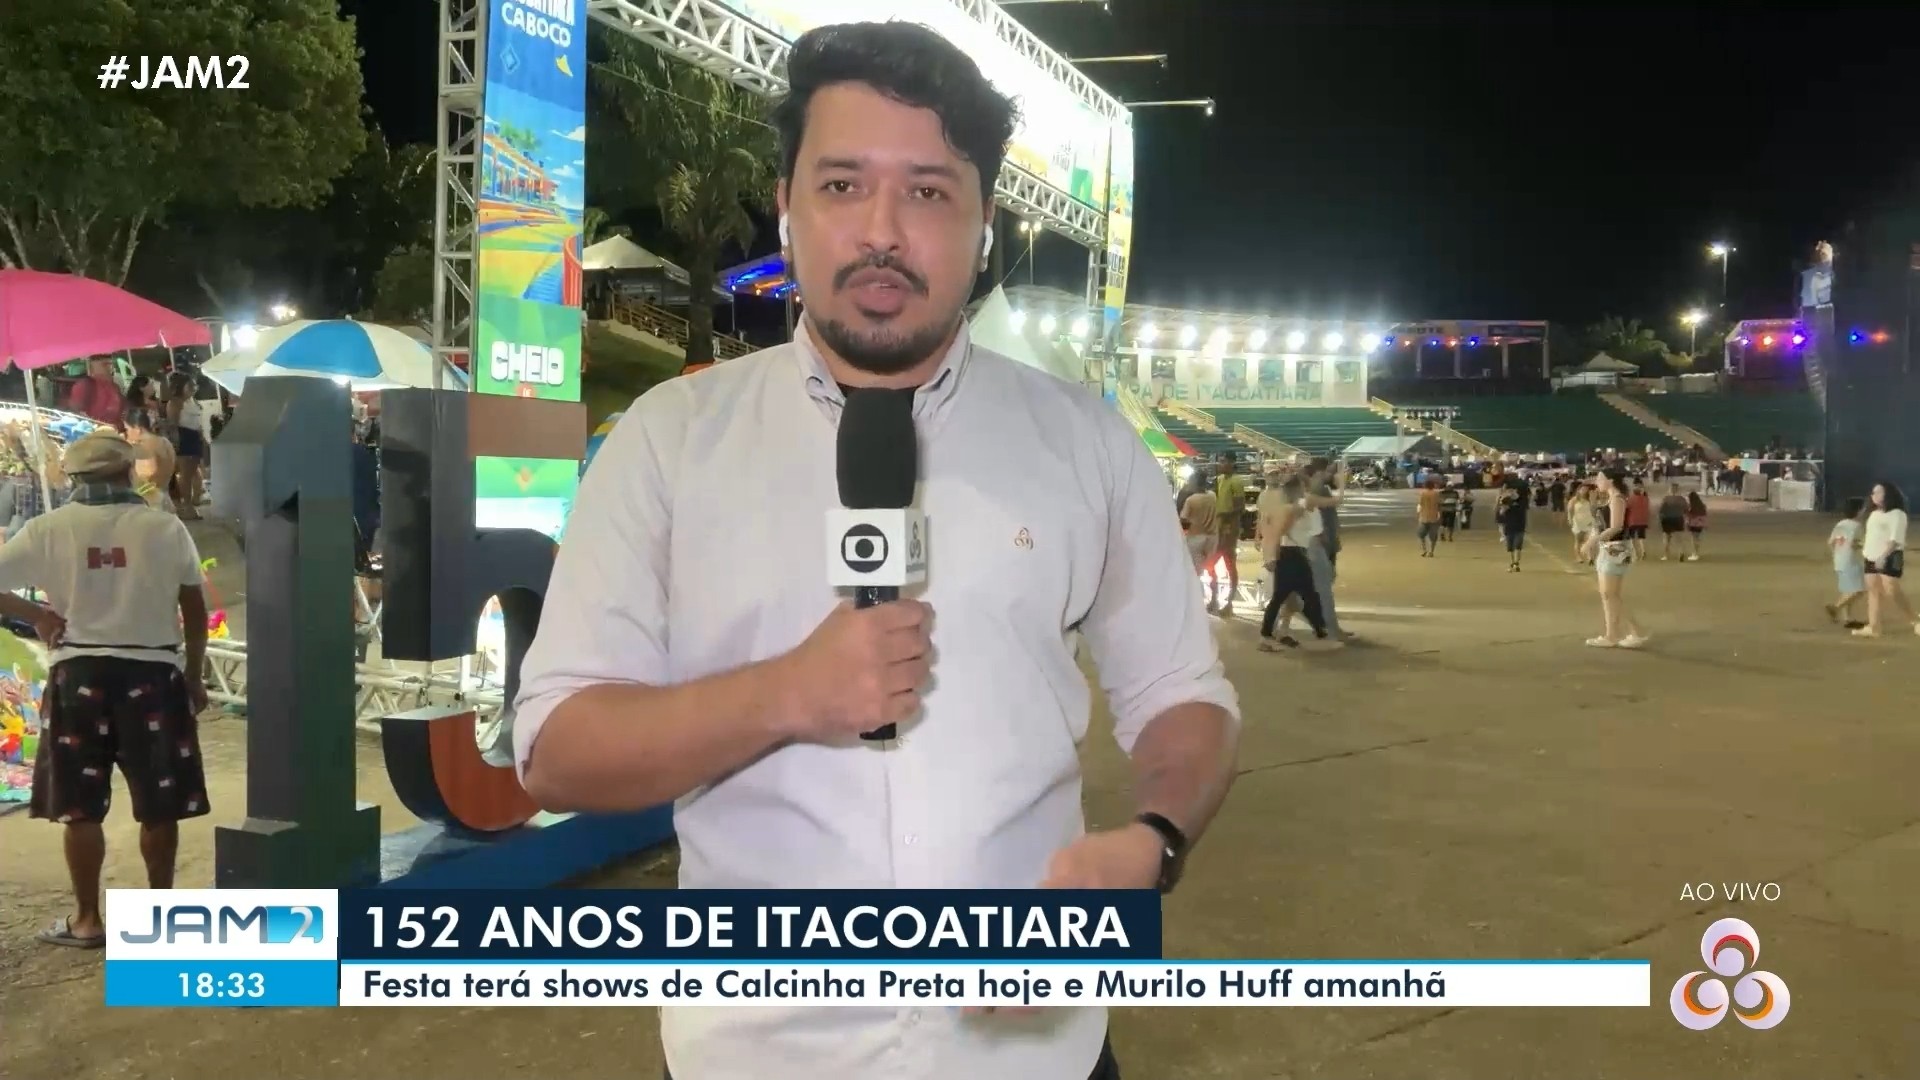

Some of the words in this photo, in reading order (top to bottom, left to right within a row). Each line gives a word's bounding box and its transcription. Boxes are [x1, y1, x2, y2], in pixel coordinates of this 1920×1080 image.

[501, 2, 571, 48] CABOCO
[490, 341, 565, 387] CHEIO
[1196, 383, 1322, 400] ITACOATIARA
